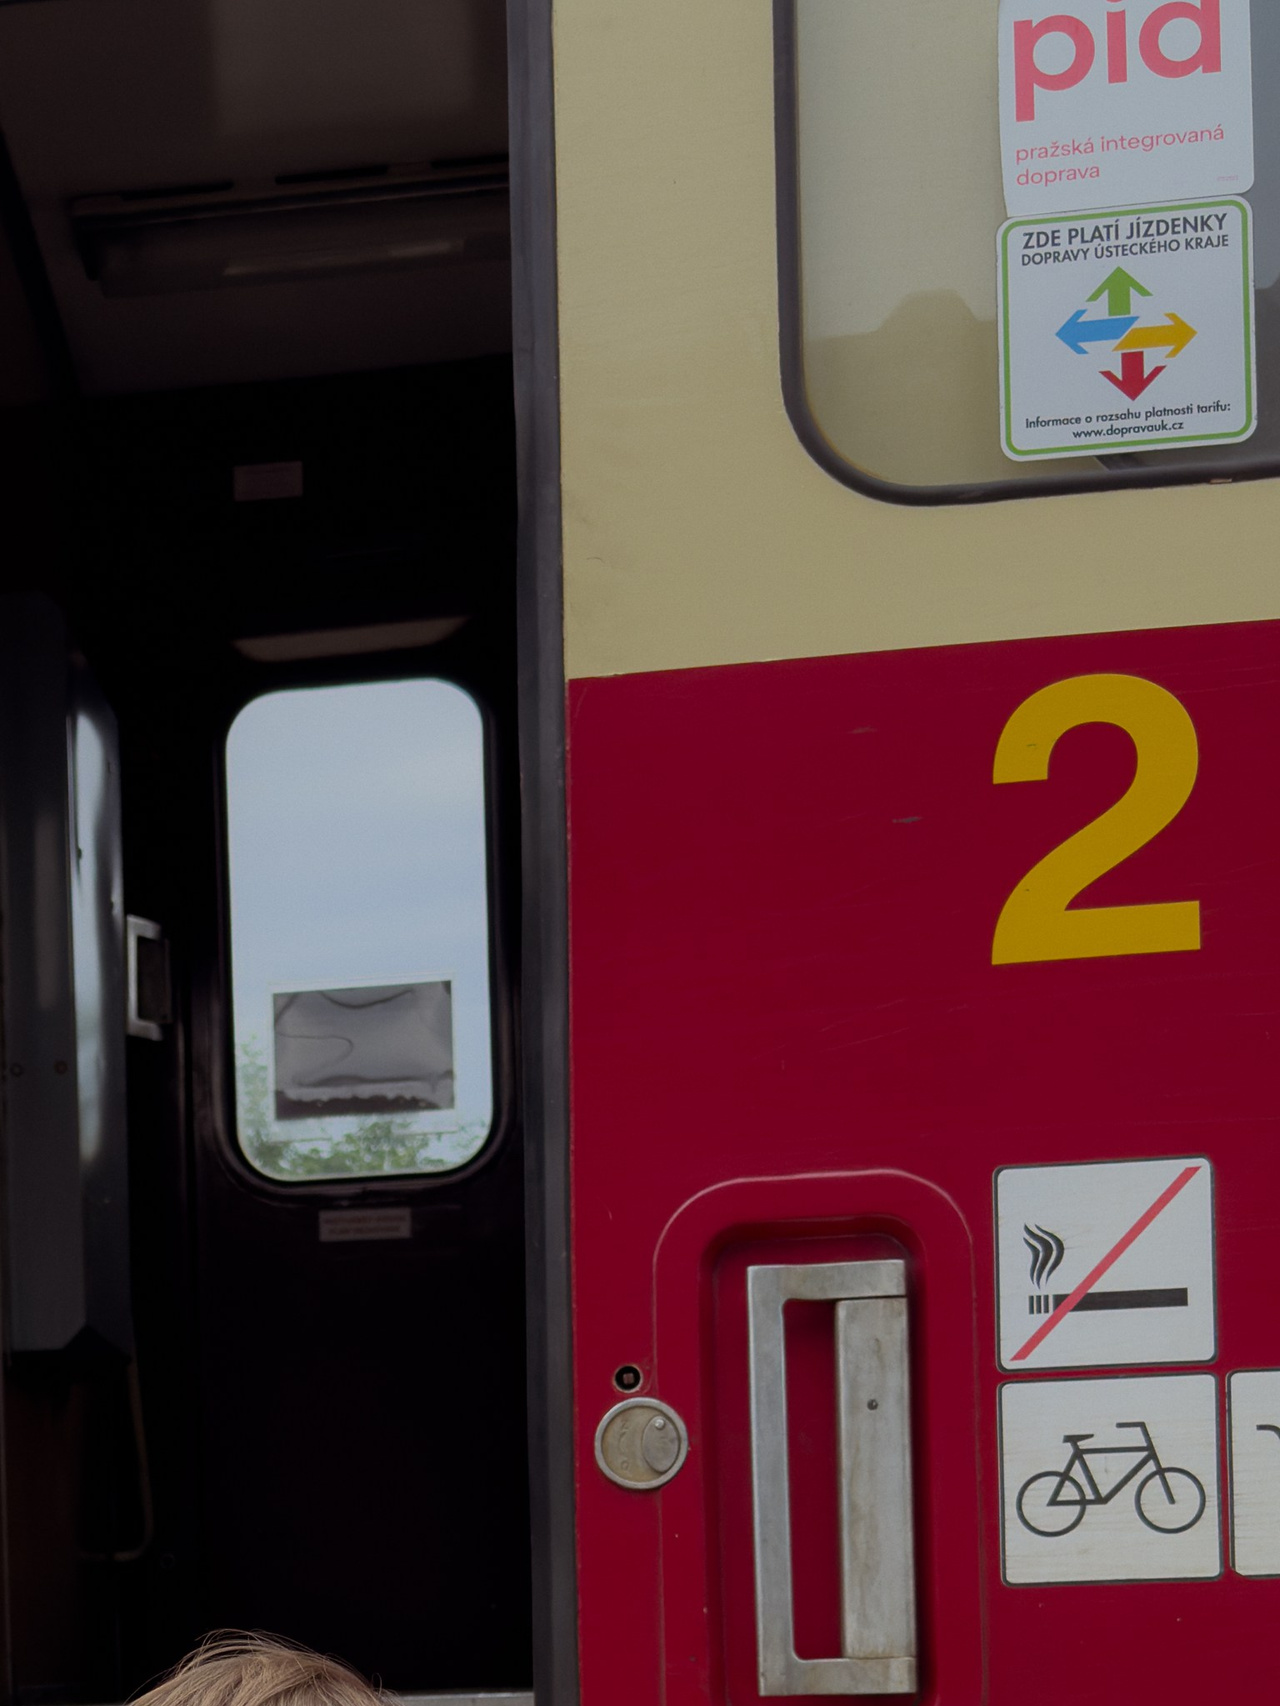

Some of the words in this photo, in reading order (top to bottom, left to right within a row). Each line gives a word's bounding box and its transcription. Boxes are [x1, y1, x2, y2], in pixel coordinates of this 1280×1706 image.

[1013, 0, 1222, 123] pid
[1015, 138, 1095, 165] pražská
[1100, 123, 1225, 152] integrovaná
[1016, 165, 1101, 187] doprava
[1022, 229, 1062, 250] ZDE
[1067, 218, 1120, 246] PLATÍ
[1125, 212, 1228, 241] JÍZDENKY
[1021, 247, 1090, 267] DOPRAVY
[1094, 239, 1181, 260] ÚSTECKÉHO
[1185, 234, 1230, 251] KRAJE
[1025, 415, 1082, 429] Informace
[1084, 415, 1093, 424] o
[1095, 408, 1141, 423] rozsahu
[1144, 403, 1194, 421] platnosti
[1196, 400, 1232, 415] tarifu:
[1072, 419, 1185, 438] www.dopravauk.cz
[991, 673, 1201, 966] 2
